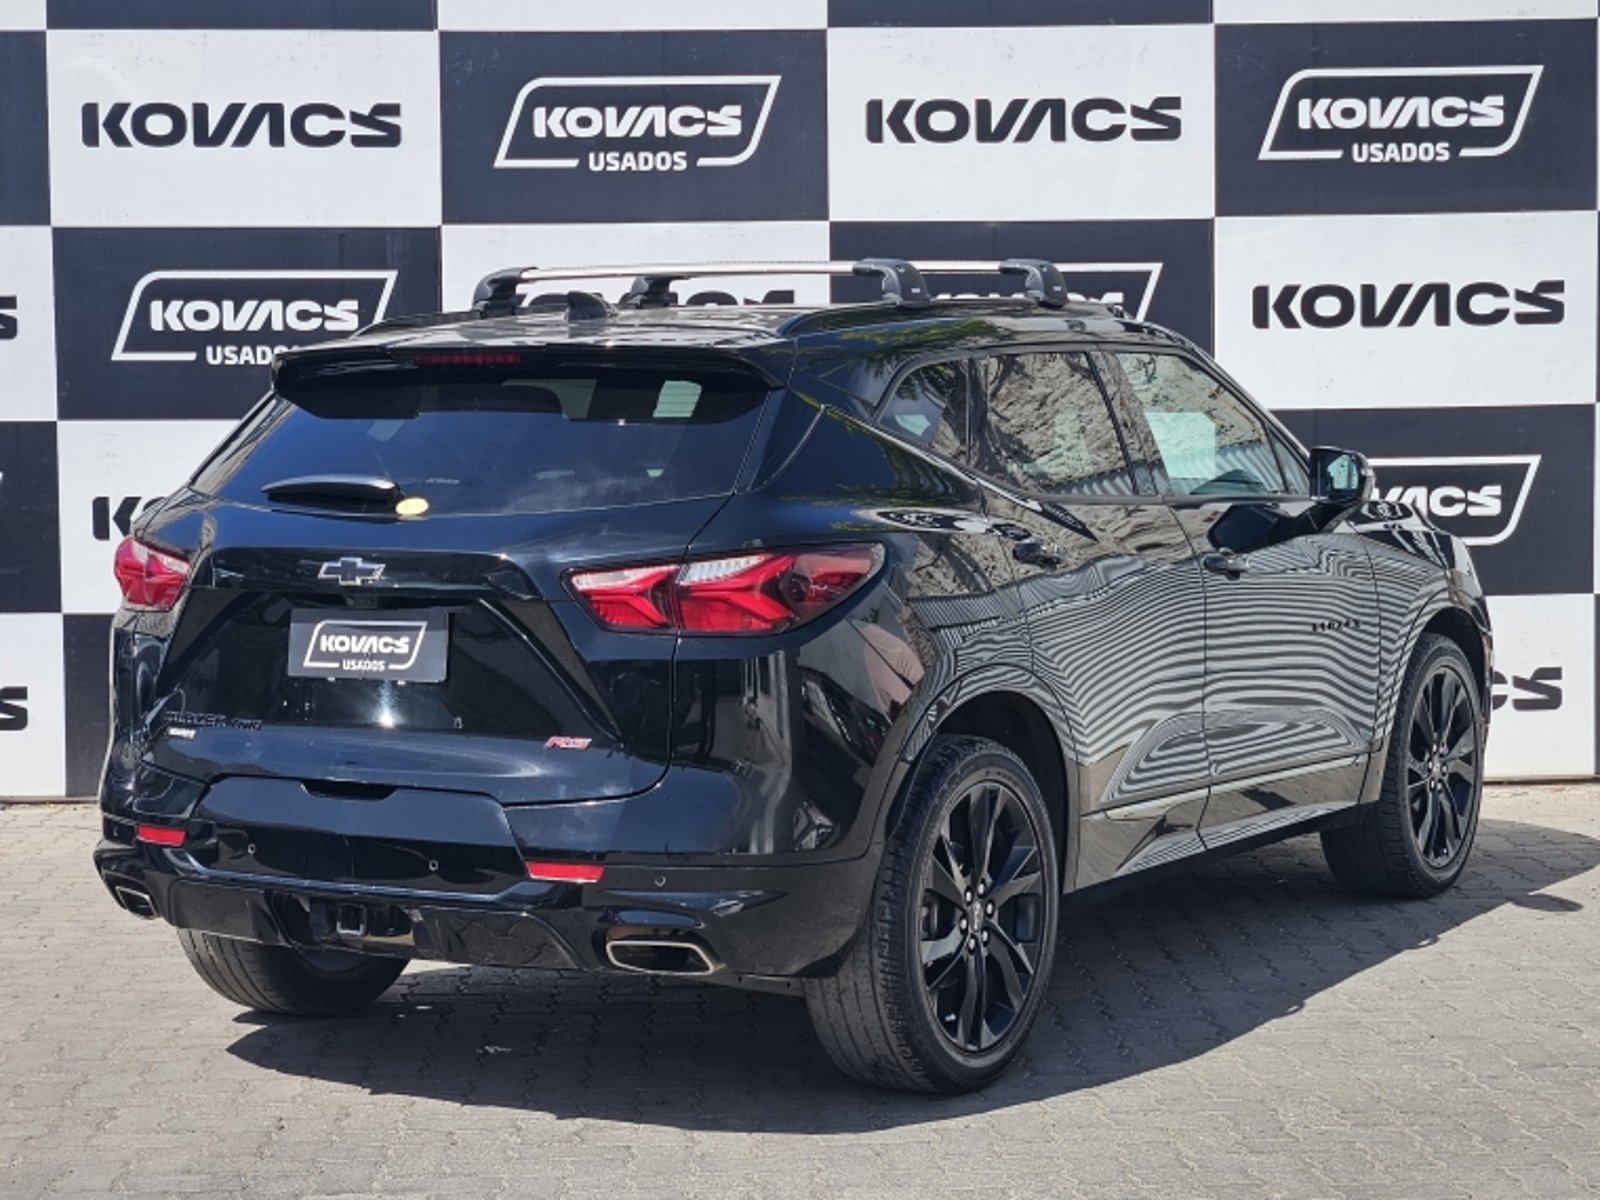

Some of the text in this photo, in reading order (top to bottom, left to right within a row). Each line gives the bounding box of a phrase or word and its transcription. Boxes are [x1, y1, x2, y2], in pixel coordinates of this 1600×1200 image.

[82, 102, 402, 148] KOVACS
[533, 104, 742, 138] KOVACS
[866, 96, 1182, 143] KOVACS
[1298, 95, 1505, 130] KOVACS
[588, 150, 688, 172] USADOS
[1352, 142, 1450, 163] USADOS
[150, 300, 359, 332] KOVACS
[1252, 280, 1565, 328] KOVACS
[205, 345, 300, 365] USAD
[320, 634, 410, 654] KOVACS
[342, 659, 387, 672] USADOS
